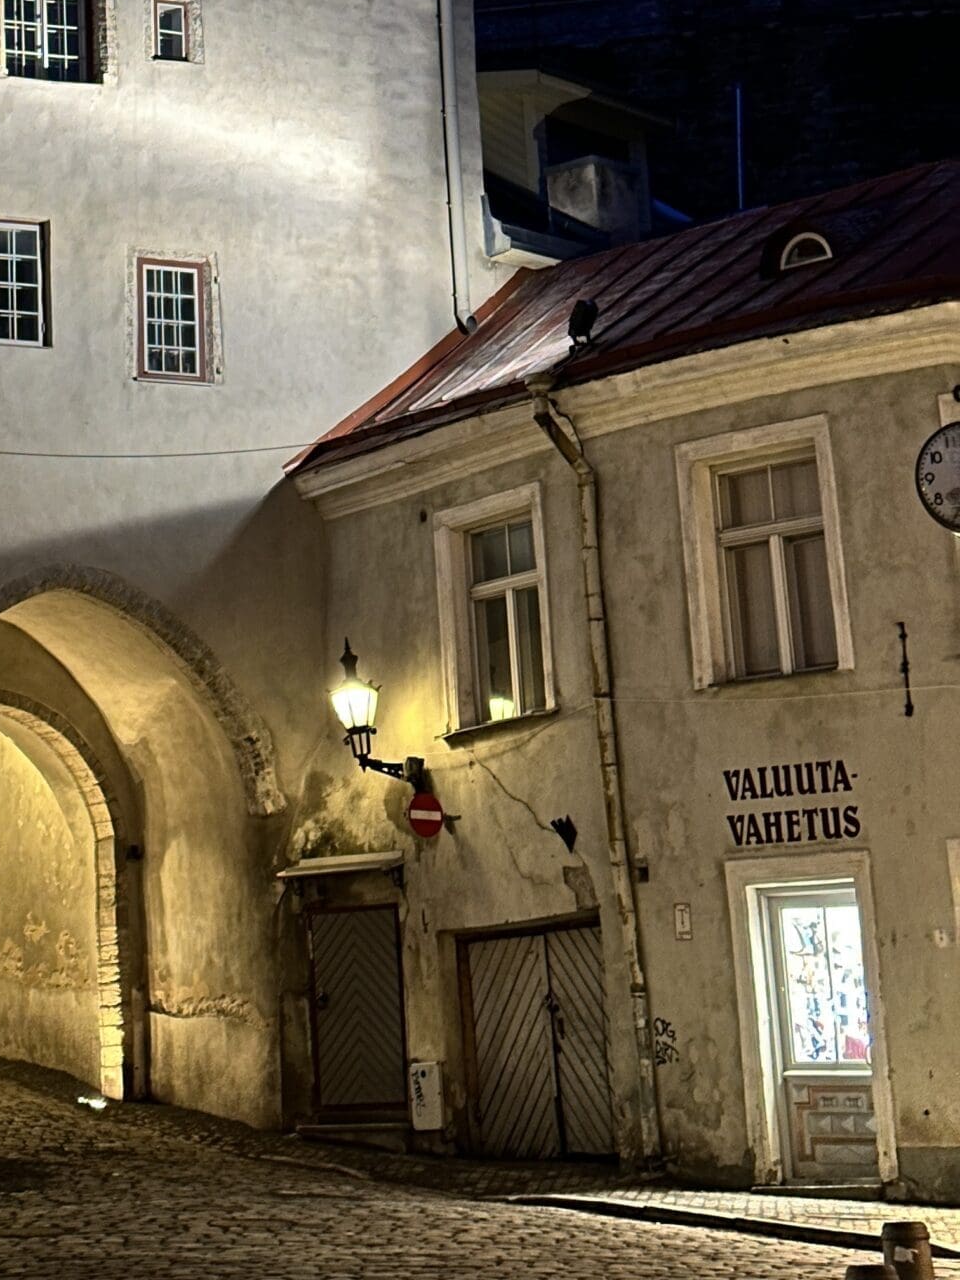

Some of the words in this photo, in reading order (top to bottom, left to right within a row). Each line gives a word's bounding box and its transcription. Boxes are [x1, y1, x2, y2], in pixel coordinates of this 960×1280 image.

[930, 451, 943, 464] 10
[924, 472, 935, 485] 9
[934, 492, 944, 506] 8
[723, 760, 858, 801] VALUUTA-
[726, 805, 861, 846] VAHETUS
